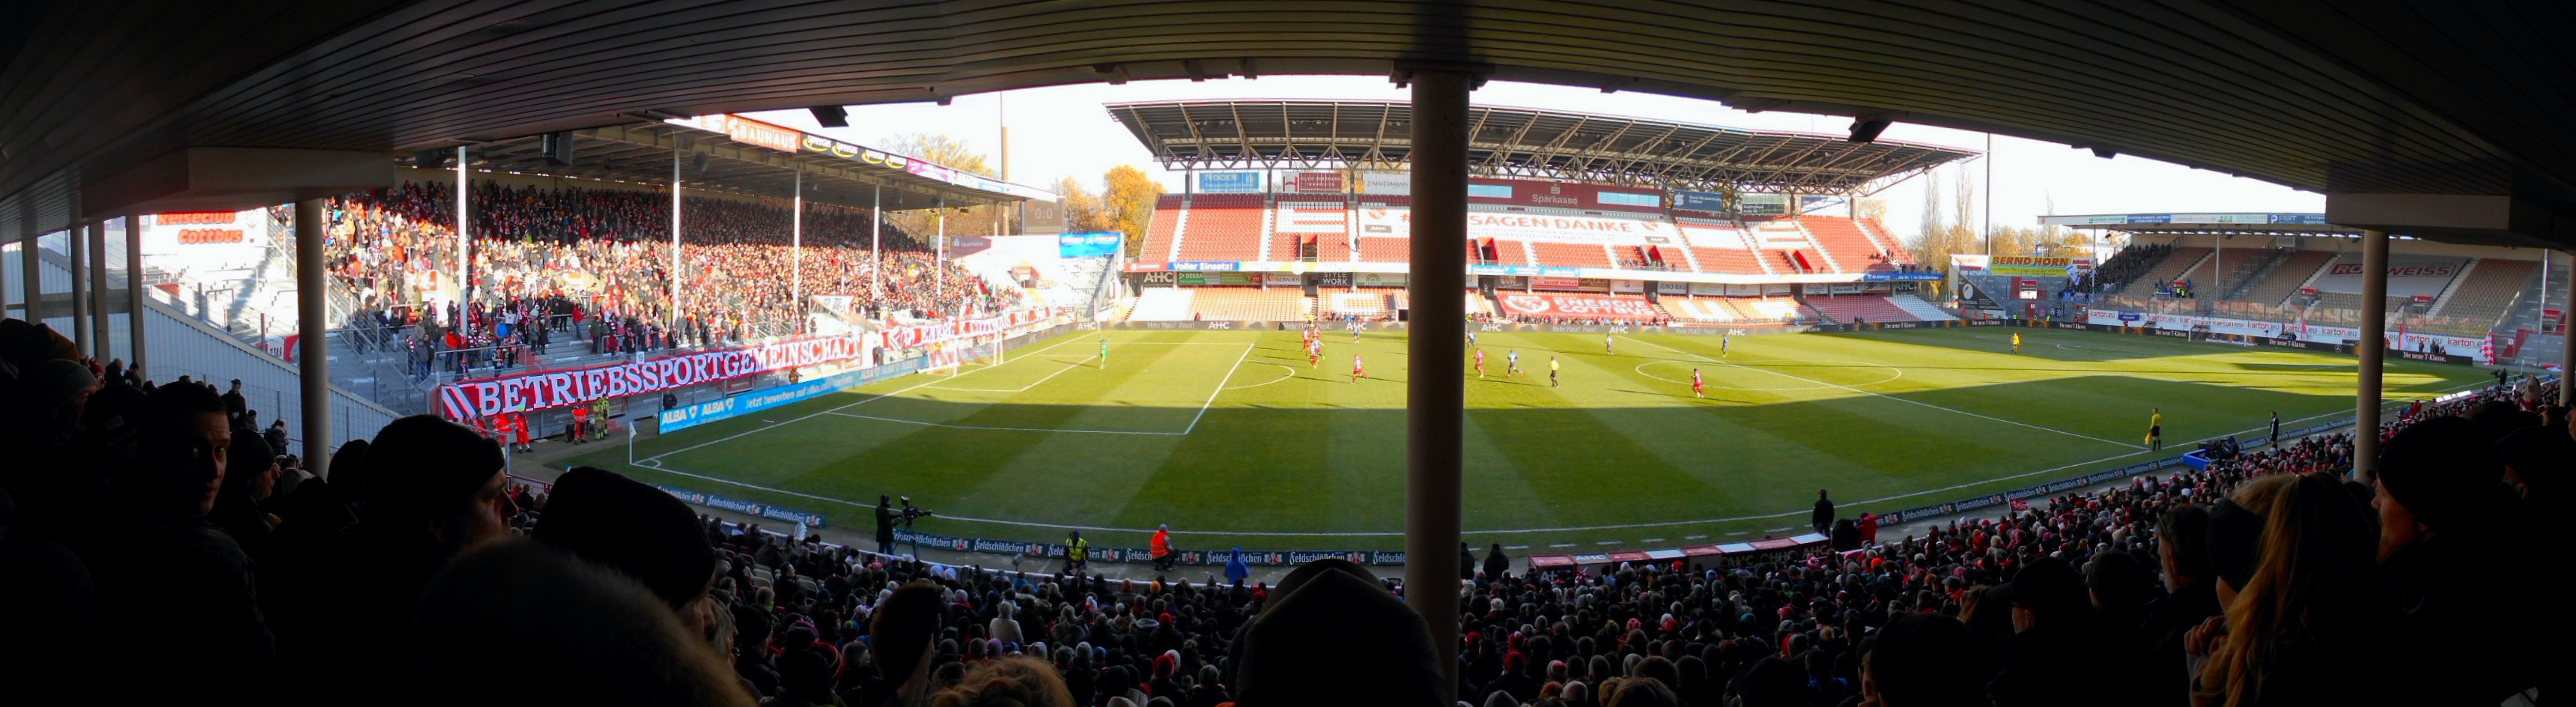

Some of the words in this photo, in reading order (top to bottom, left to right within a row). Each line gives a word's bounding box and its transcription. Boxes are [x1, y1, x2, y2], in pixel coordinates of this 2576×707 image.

[740, 124, 798, 151] BAUHAUS
[1532, 194, 1579, 205] Sparkasse
[1034, 207, 1054, 219] 0:0
[1469, 215, 1549, 228] SAGEN
[1554, 218, 1635, 233] DANKE
[178, 228, 243, 244] Cottbus
[1992, 256, 2032, 264] BERND
[2035, 257, 2070, 266] HORN
[2335, 264, 2363, 273] RO
[1143, 272, 1173, 282] AHC
[1896, 282, 1914, 290] AHC
[1555, 297, 1647, 308] ENERGIE
[1558, 306, 1656, 317] COTTBUS
[2090, 310, 2115, 318] karton.eu
[2148, 314, 2176, 322] karton.eu
[1077, 322, 1096, 330] AHC
[1208, 321, 1230, 330] AHC
[1346, 322, 1367, 330] AHC
[1481, 324, 1502, 332] AHC
[1609, 326, 1629, 334] AHC
[2247, 321, 2279, 330] karton.eu
[2322, 327, 2358, 337] karton.eu
[2448, 338, 2482, 348] karton.e
[2424, 353, 2446, 362] T-Klasse.
[476, 337, 861, 416] BETRIEBSSPORTGEMEINSCHAFT
[661, 408, 687, 425] ALBA
[702, 400, 726, 416] ALBA
[745, 398, 762, 409] Jetzt
[763, 390, 795, 405] bewerben
[796, 386, 808, 398] auf
[2048, 478, 2077, 492] Feldschlößchen
[2005, 488, 2036, 500] Feldschlößchen
[708, 494, 746, 511] Feldschlößchen
[1956, 498, 1990, 512] Feldschlößchen
[764, 506, 804, 522] Feldschlößchen
[1902, 507, 1939, 522] Feldschlößchen
[974, 537, 1024, 553] Feldschlößchen
[1802, 544, 1828, 559] AHC
